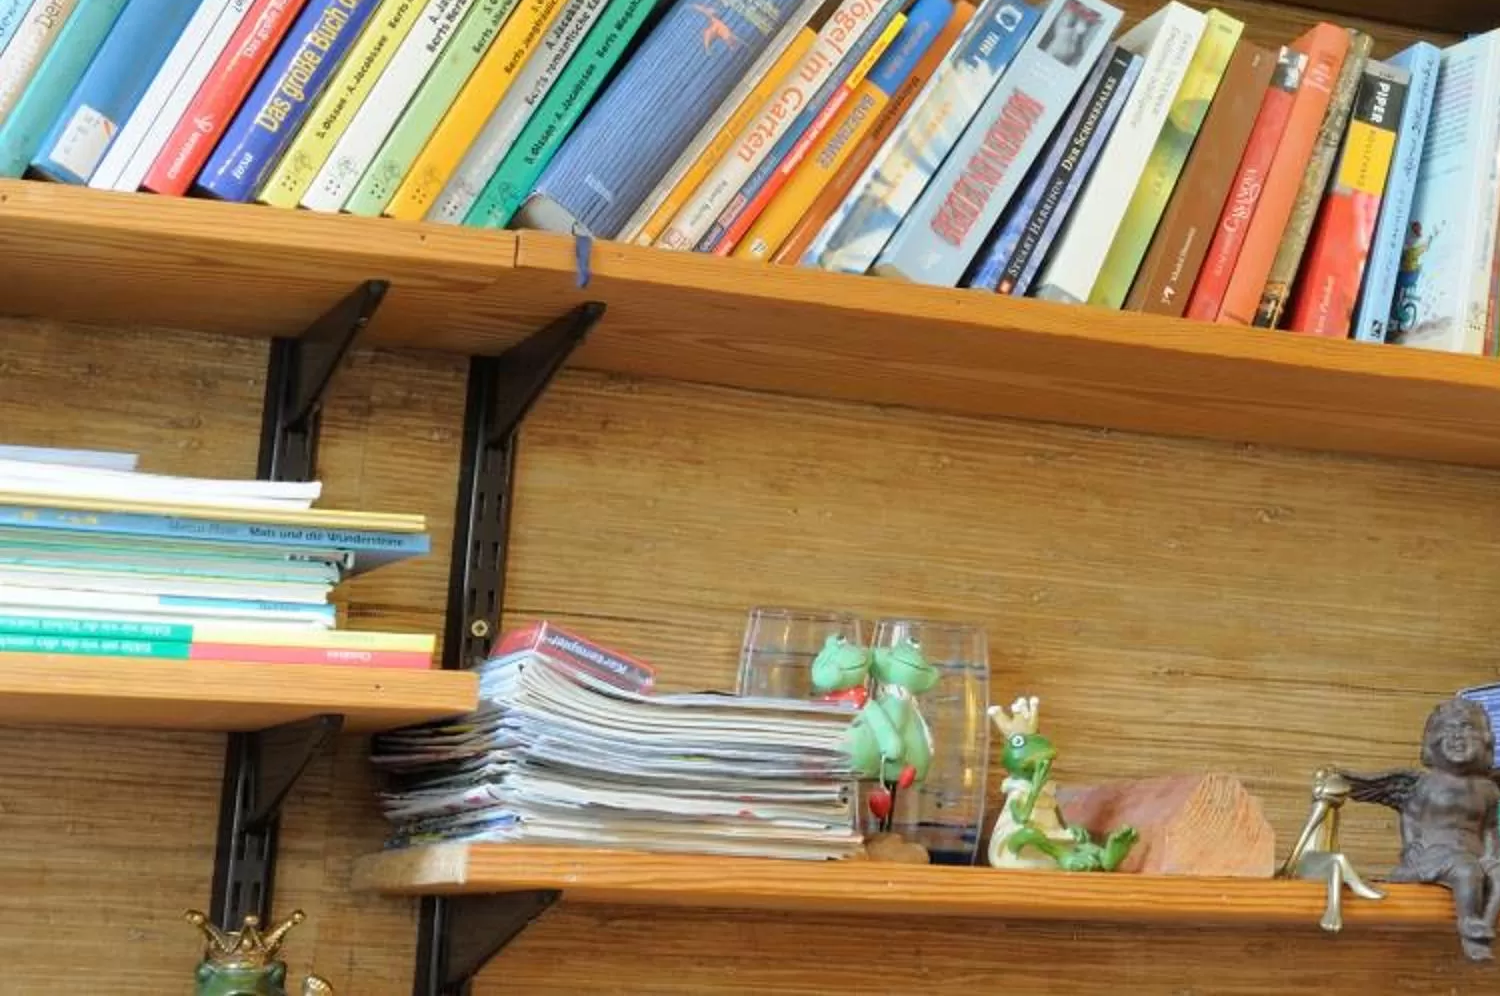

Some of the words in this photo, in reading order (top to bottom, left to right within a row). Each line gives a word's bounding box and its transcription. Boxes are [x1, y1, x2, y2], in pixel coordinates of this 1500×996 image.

[385, 0, 412, 30] Berts
[423, 19, 454, 54] Berts
[469, 24, 496, 55] Berts
[594, 30, 619, 59] Berts
[253, 90, 293, 135] Das
[275, 44, 325, 103] große
[303, 1, 348, 53] Buch
[501, 45, 528, 75] Berts
[794, 45, 831, 85] im
[1369, 81, 1391, 124] PIPER
[732, 78, 805, 166] Garten
[249, 526, 276, 539] Mats
[278, 529, 302, 540] und
[305, 530, 324, 542] die
[327, 532, 404, 548] Wundersteine
